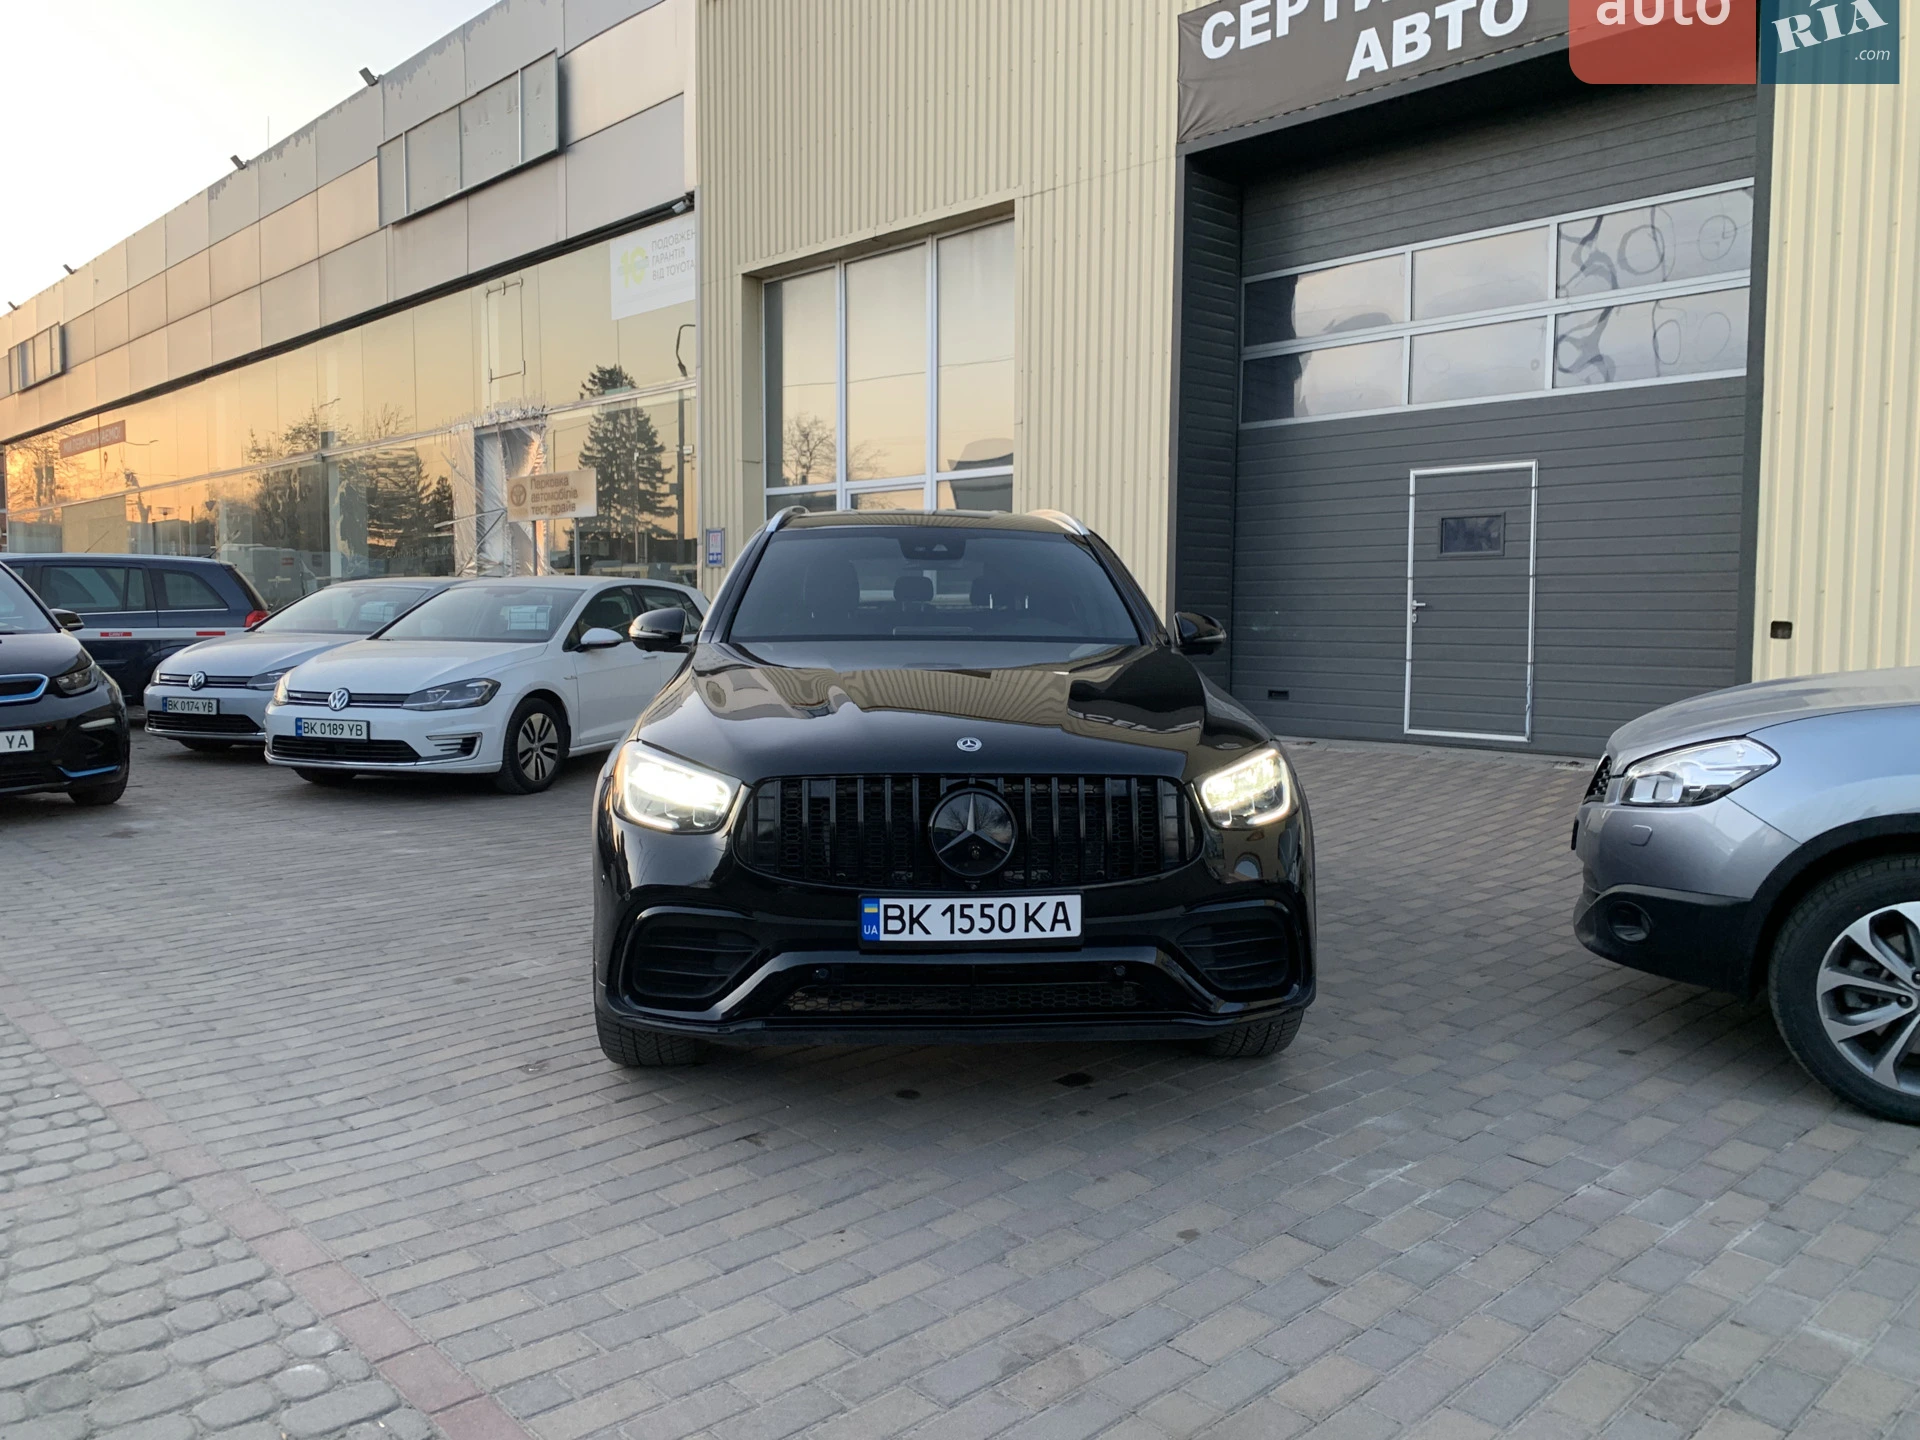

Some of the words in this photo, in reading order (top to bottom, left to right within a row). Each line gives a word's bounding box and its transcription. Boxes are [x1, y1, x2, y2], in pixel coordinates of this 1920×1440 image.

[1345, 0, 1529, 82] АВТО
[531, 501, 576, 516] тест-драйв
[168, 700, 179, 711] BK
[180, 700, 199, 712] 0174
[201, 701, 214, 713] YB
[303, 722, 317, 734] BK
[320, 722, 344, 735] 0189
[347, 723, 363, 737] YB
[883, 904, 932, 935] BK
[940, 903, 1016, 934] 1550
[1024, 901, 1072, 933] KA
[863, 925, 878, 935] UA
